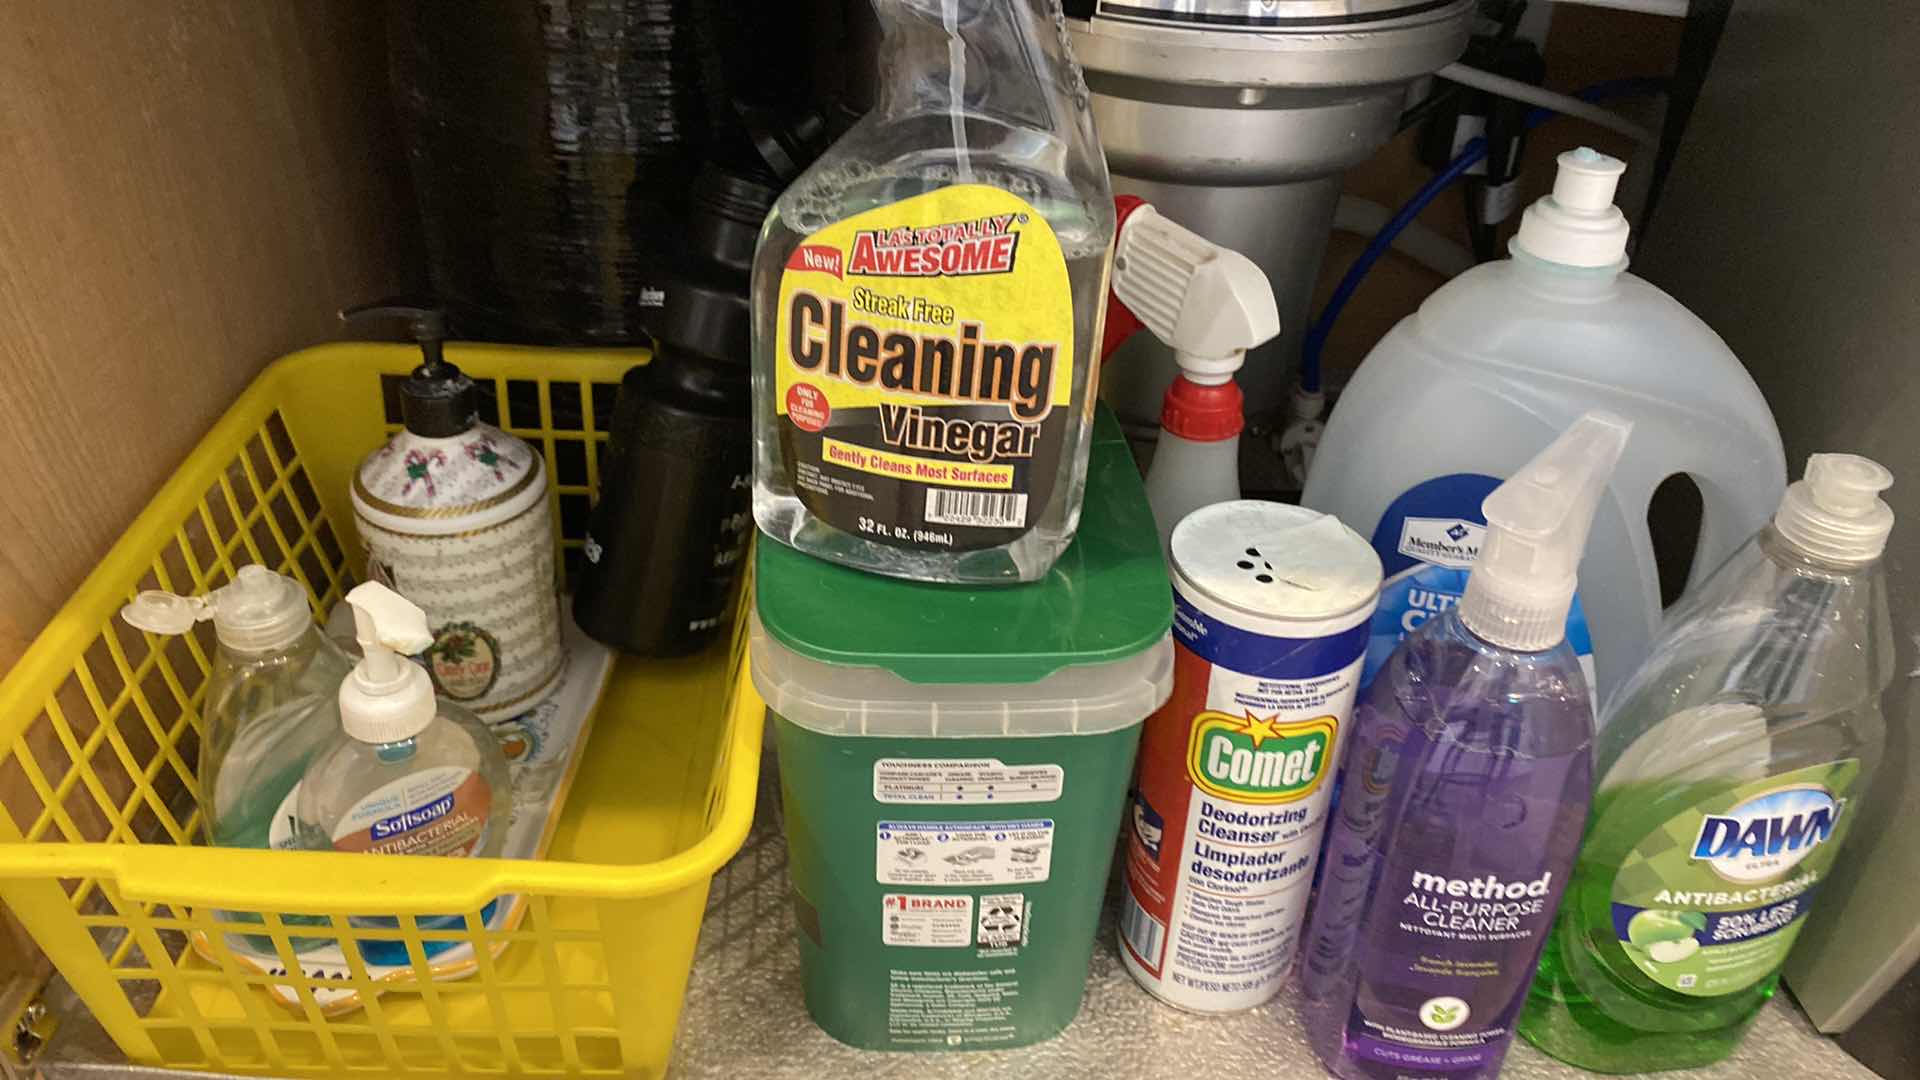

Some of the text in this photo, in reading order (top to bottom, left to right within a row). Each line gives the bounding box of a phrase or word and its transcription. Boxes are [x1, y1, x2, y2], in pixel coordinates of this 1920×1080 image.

[915, 213, 1016, 245] TOTALLY
[803, 248, 841, 273] New!
[848, 230, 1019, 277] AWESOME
[853, 286, 955, 325] Streak Free
[790, 290, 1058, 422] Cleaning
[796, 385, 818, 400] ONLY
[879, 403, 1041, 463] Vinegar
[829, 445, 867, 468] Gently
[870, 455, 912, 475] Cleans
[915, 463, 948, 480] Most
[951, 467, 1009, 485] Surfaces
[857, 516, 953, 546] 32 FL. OZ. (946mL)
[1408, 589, 1462, 612] ULT
[1207, 735, 1321, 788] Comet
[375, 799, 452, 837] Softsoap
[1200, 801, 1308, 828] Deodorizing
[1197, 818, 1281, 844] Cleanser
[1690, 801, 1843, 860] DAWN
[1191, 854, 1309, 884] desodorizante
[1193, 841, 1287, 867] Limpiador
[1412, 870, 1553, 900] method
[1654, 870, 1818, 905] ANTIBACTERIAL
[885, 895, 967, 911] #1 BRAND
[1403, 892, 1545, 917] ALL-PURPOSE
[1421, 911, 1521, 932] CLEANER
